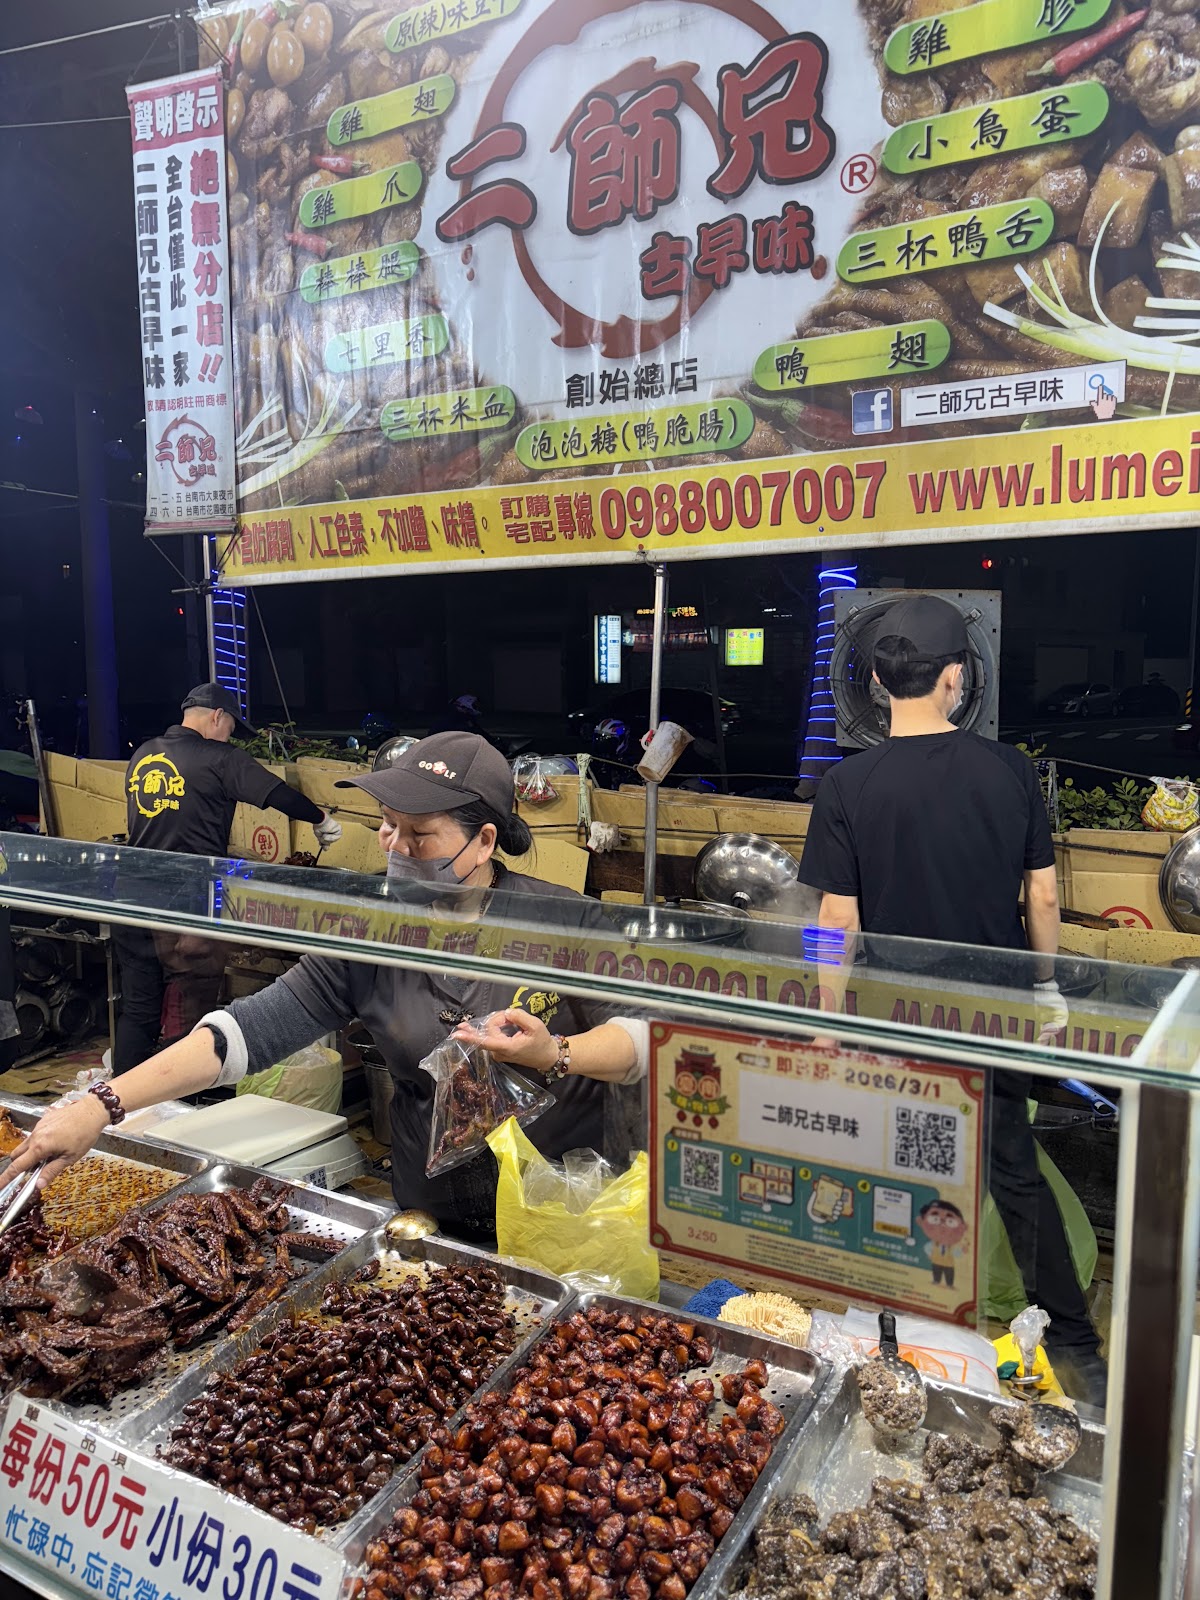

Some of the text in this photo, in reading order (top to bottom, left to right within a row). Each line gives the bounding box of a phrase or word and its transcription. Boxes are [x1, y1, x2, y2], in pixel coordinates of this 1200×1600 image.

[339, 86, 439, 141] 雞翅
[436, 31, 837, 243] 二師兄
[907, 95, 1080, 160] 小鳥蛋
[312, 171, 408, 224] 雞爪
[640, 200, 815, 300] 古早味
[848, 207, 1043, 275] 三杯鴨舌
[137, 163, 166, 389] 二師兄古早味
[165, 154, 190, 388] 全台僅此一家
[315, 252, 404, 297] 棒棒腿
[339, 324, 433, 363] 七里香
[775, 331, 930, 385] 鴨翅
[565, 358, 698, 409] 創始總店
[915, 378, 1064, 417] 二師兄古早味
[387, 392, 511, 434] 三杯米血
[530, 407, 738, 461] 泡泡糖(鴨脆腸)
[155, 435, 217, 463] 二師兄
[907, 431, 1200, 514] www.lumei
[501, 495, 551, 519] 訂購
[553, 491, 597, 541] 專線
[599, 461, 886, 539] 0988007007
[504, 520, 556, 544] 宅配
[128, 773, 186, 796] 二師兄
[153, 798, 180, 811] 古早味
[762, 1103, 859, 1138] 二師兄古早味
[1, 1418, 147, 1550] 每份50元
